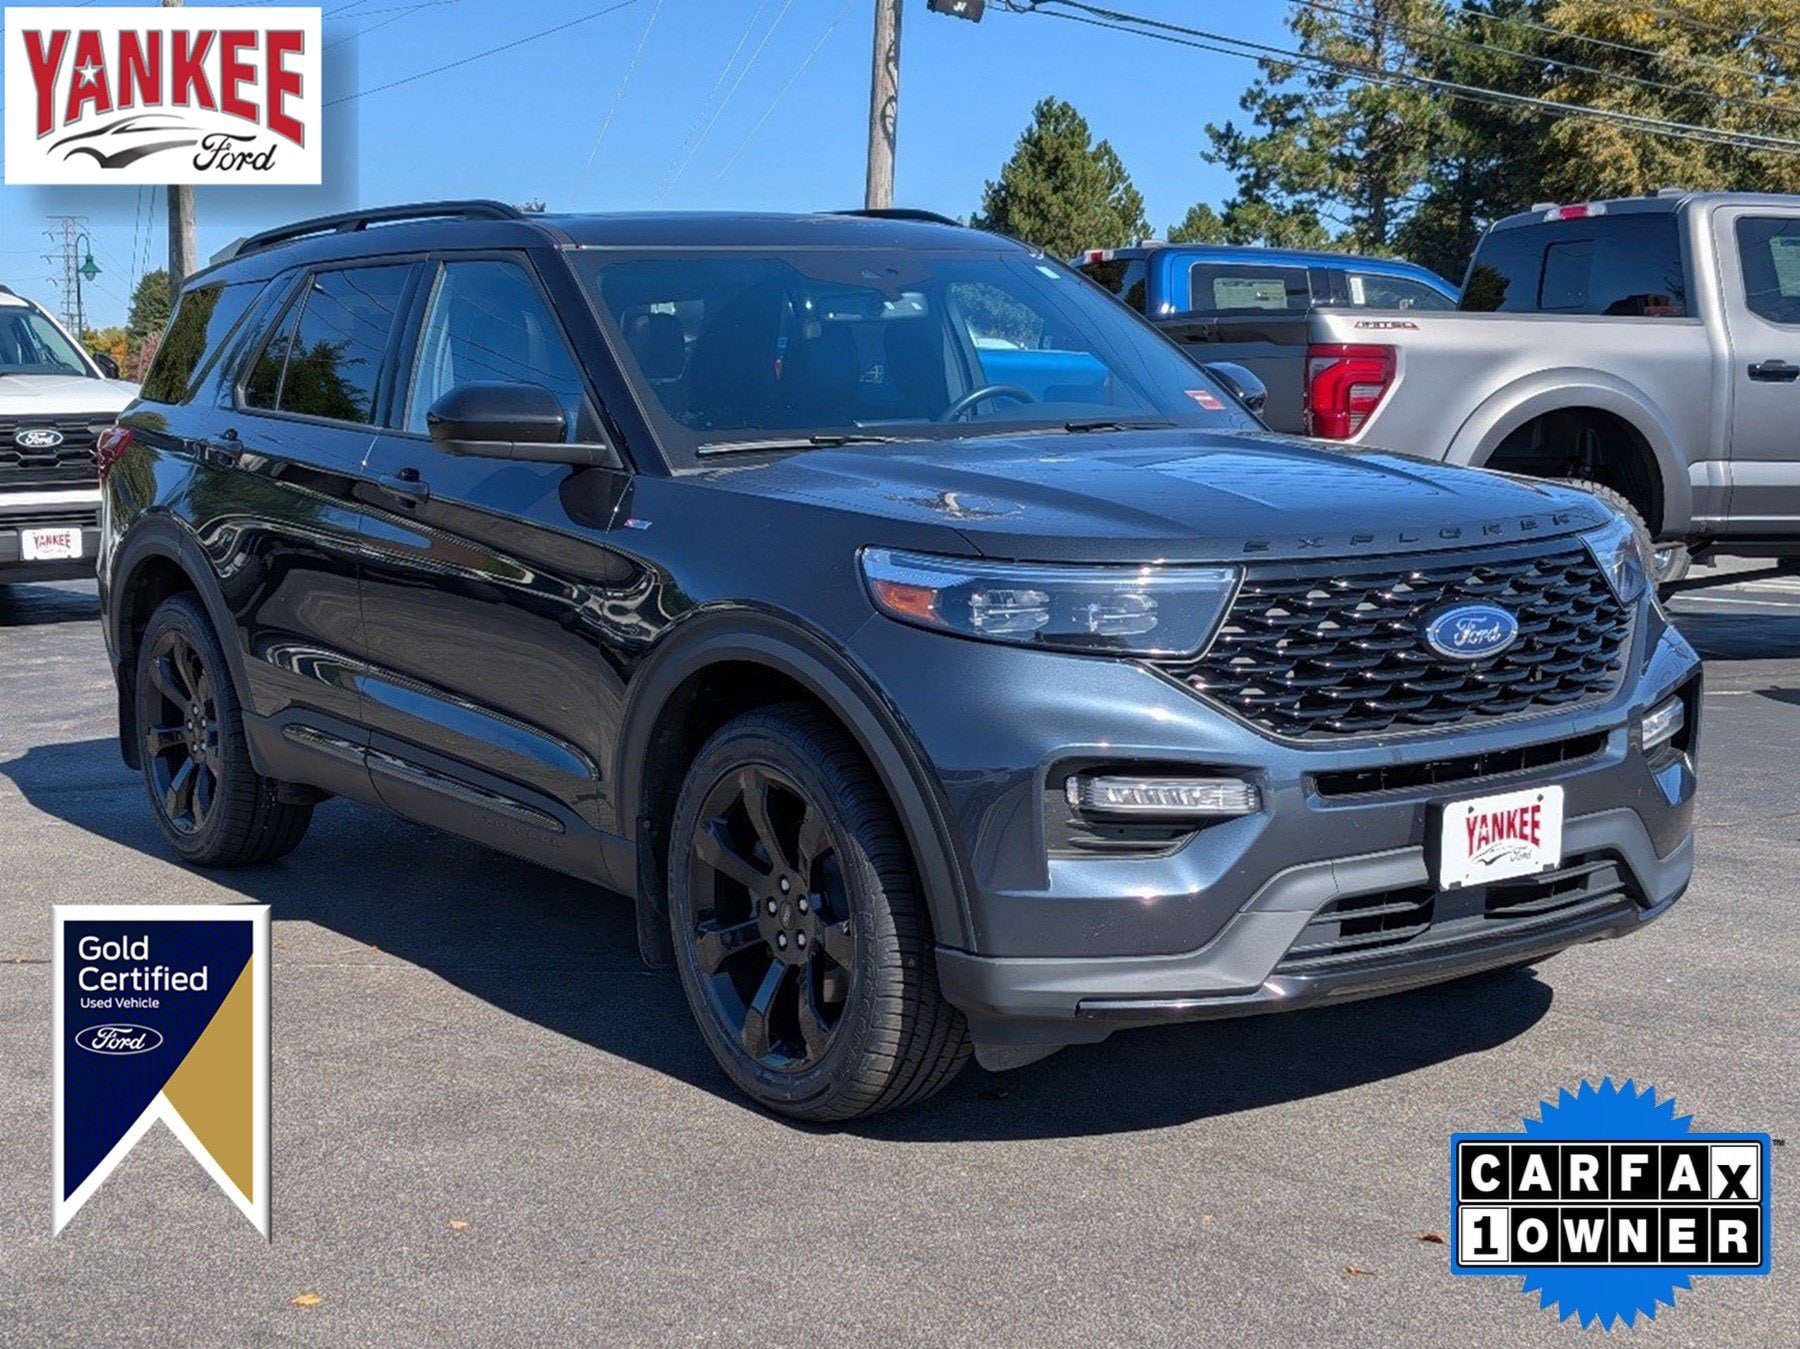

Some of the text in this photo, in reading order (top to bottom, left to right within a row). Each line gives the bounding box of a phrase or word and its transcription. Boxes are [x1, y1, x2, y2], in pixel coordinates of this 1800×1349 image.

[25, 432, 54, 445] Ford
[33, 533, 71, 549] YANKEE
[1243, 513, 1570, 552] EXPLORER
[1453, 616, 1501, 648] Ford
[1465, 804, 1541, 858] YANKEE
